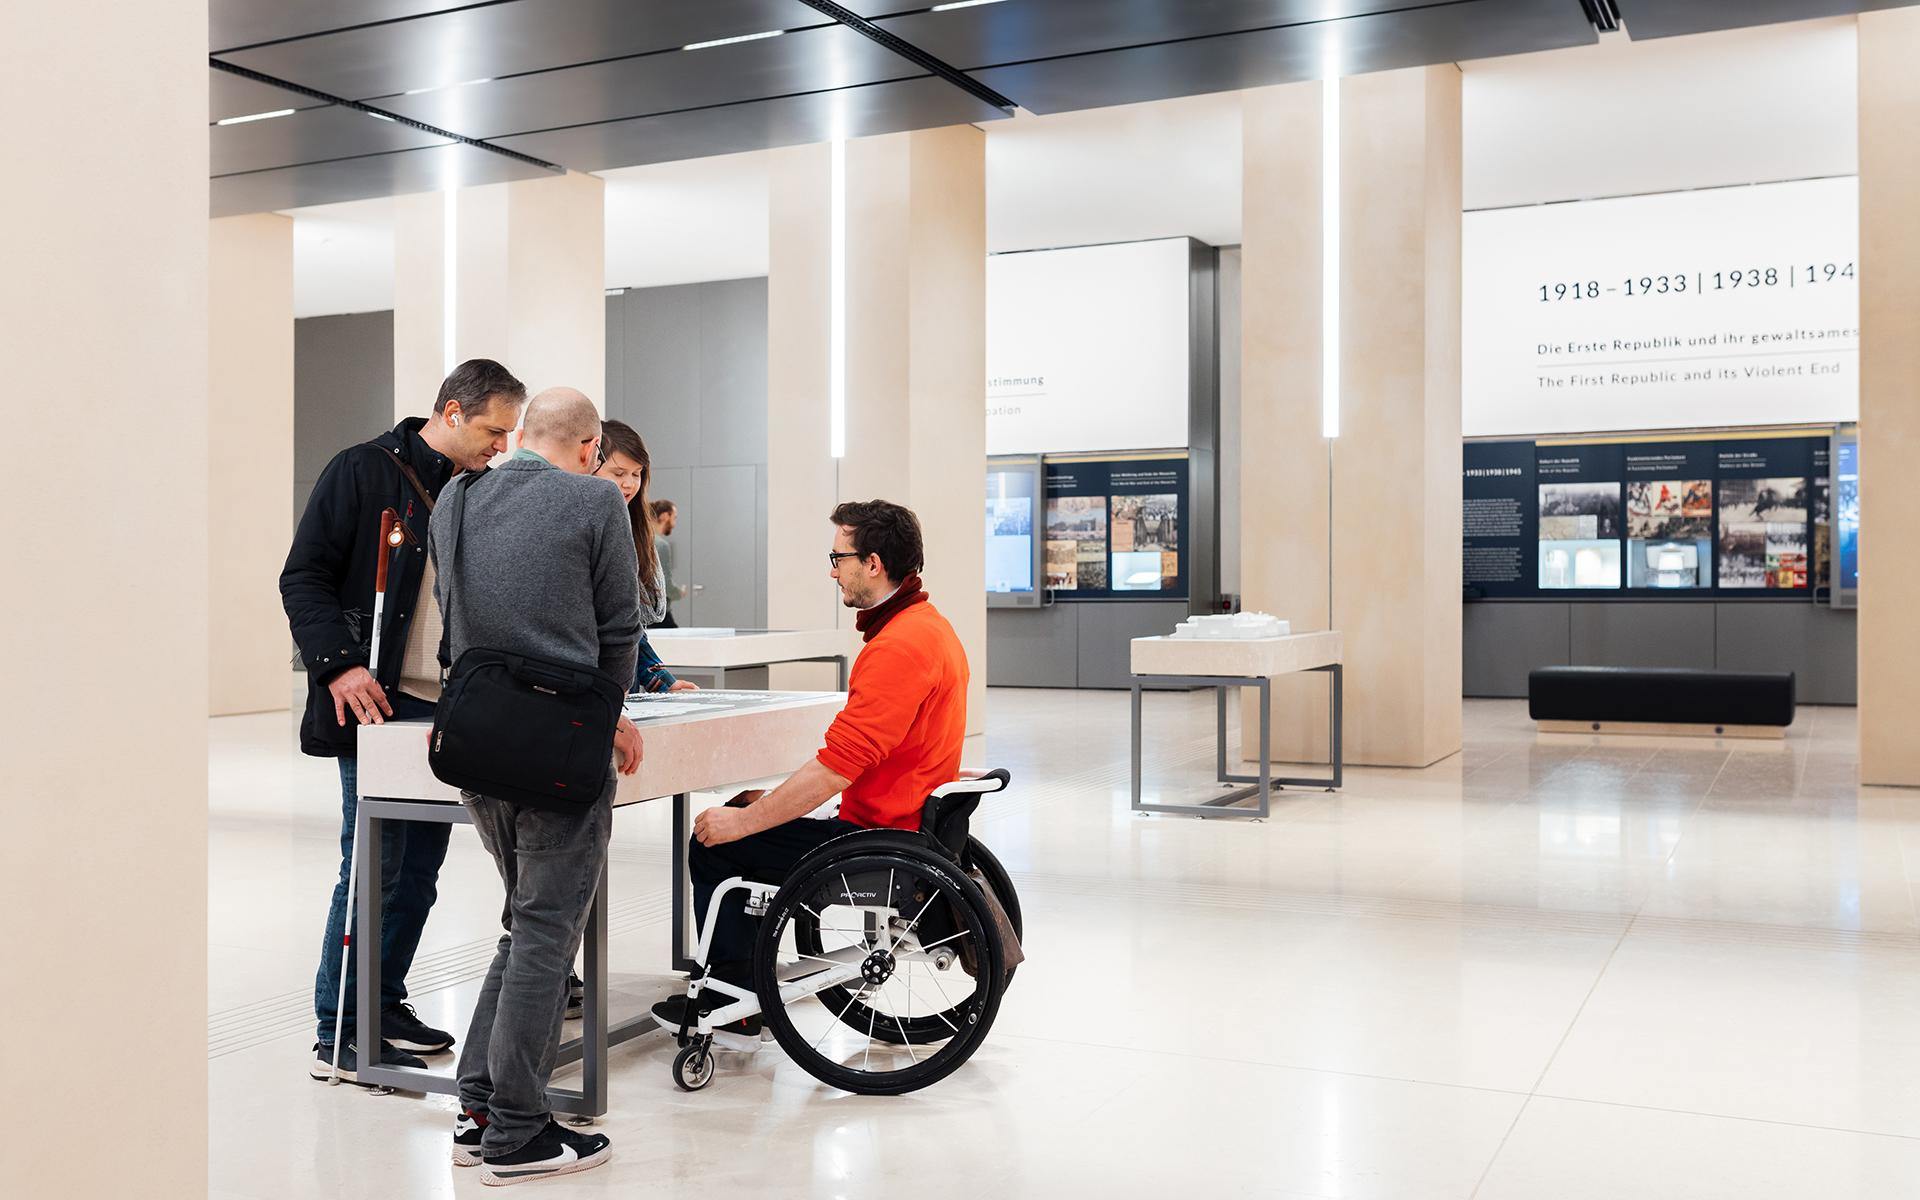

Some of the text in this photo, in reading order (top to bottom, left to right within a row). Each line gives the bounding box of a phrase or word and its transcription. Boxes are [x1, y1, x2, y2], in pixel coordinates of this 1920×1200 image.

[1713, 267, 1779, 290] 1938
[1537, 343, 1562, 355] Die
[1568, 342, 1607, 353] Erste
[1613, 336, 1682, 352] Republik
[1688, 333, 1717, 346] und
[1723, 332, 1744, 344] ihr
[1537, 362, 1841, 388] The First Republic and its Violent End
